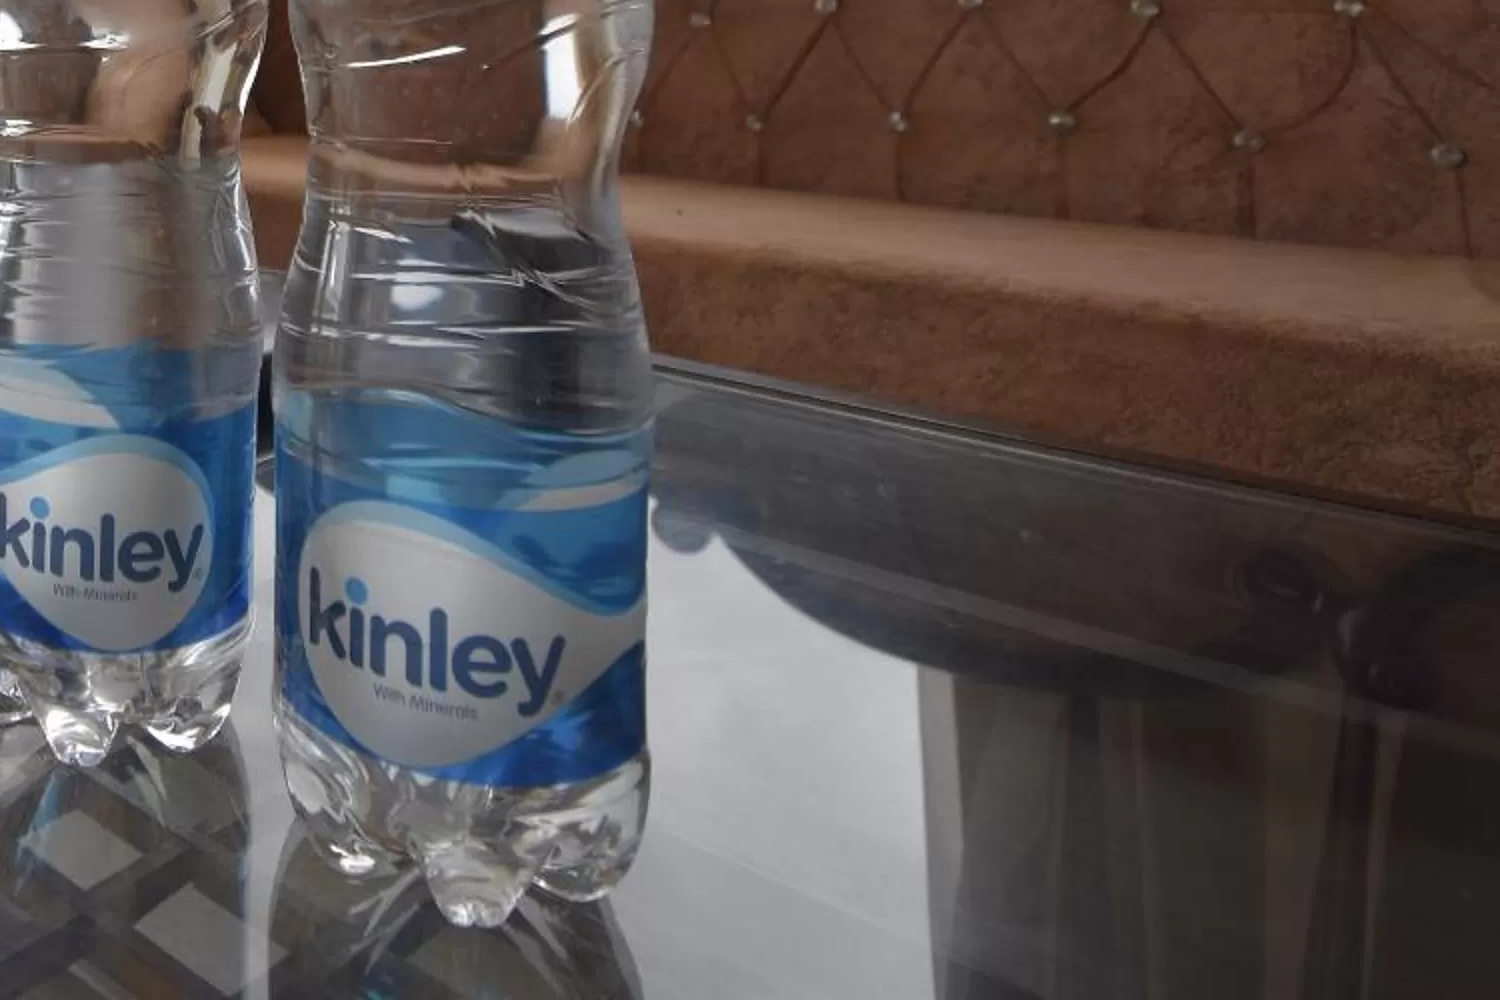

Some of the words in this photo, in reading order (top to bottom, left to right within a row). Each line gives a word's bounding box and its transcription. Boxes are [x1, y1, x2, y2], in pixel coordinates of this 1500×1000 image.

[309, 566, 567, 719] kinley
[373, 682, 406, 707] With
[409, 694, 478, 721] Minerals
